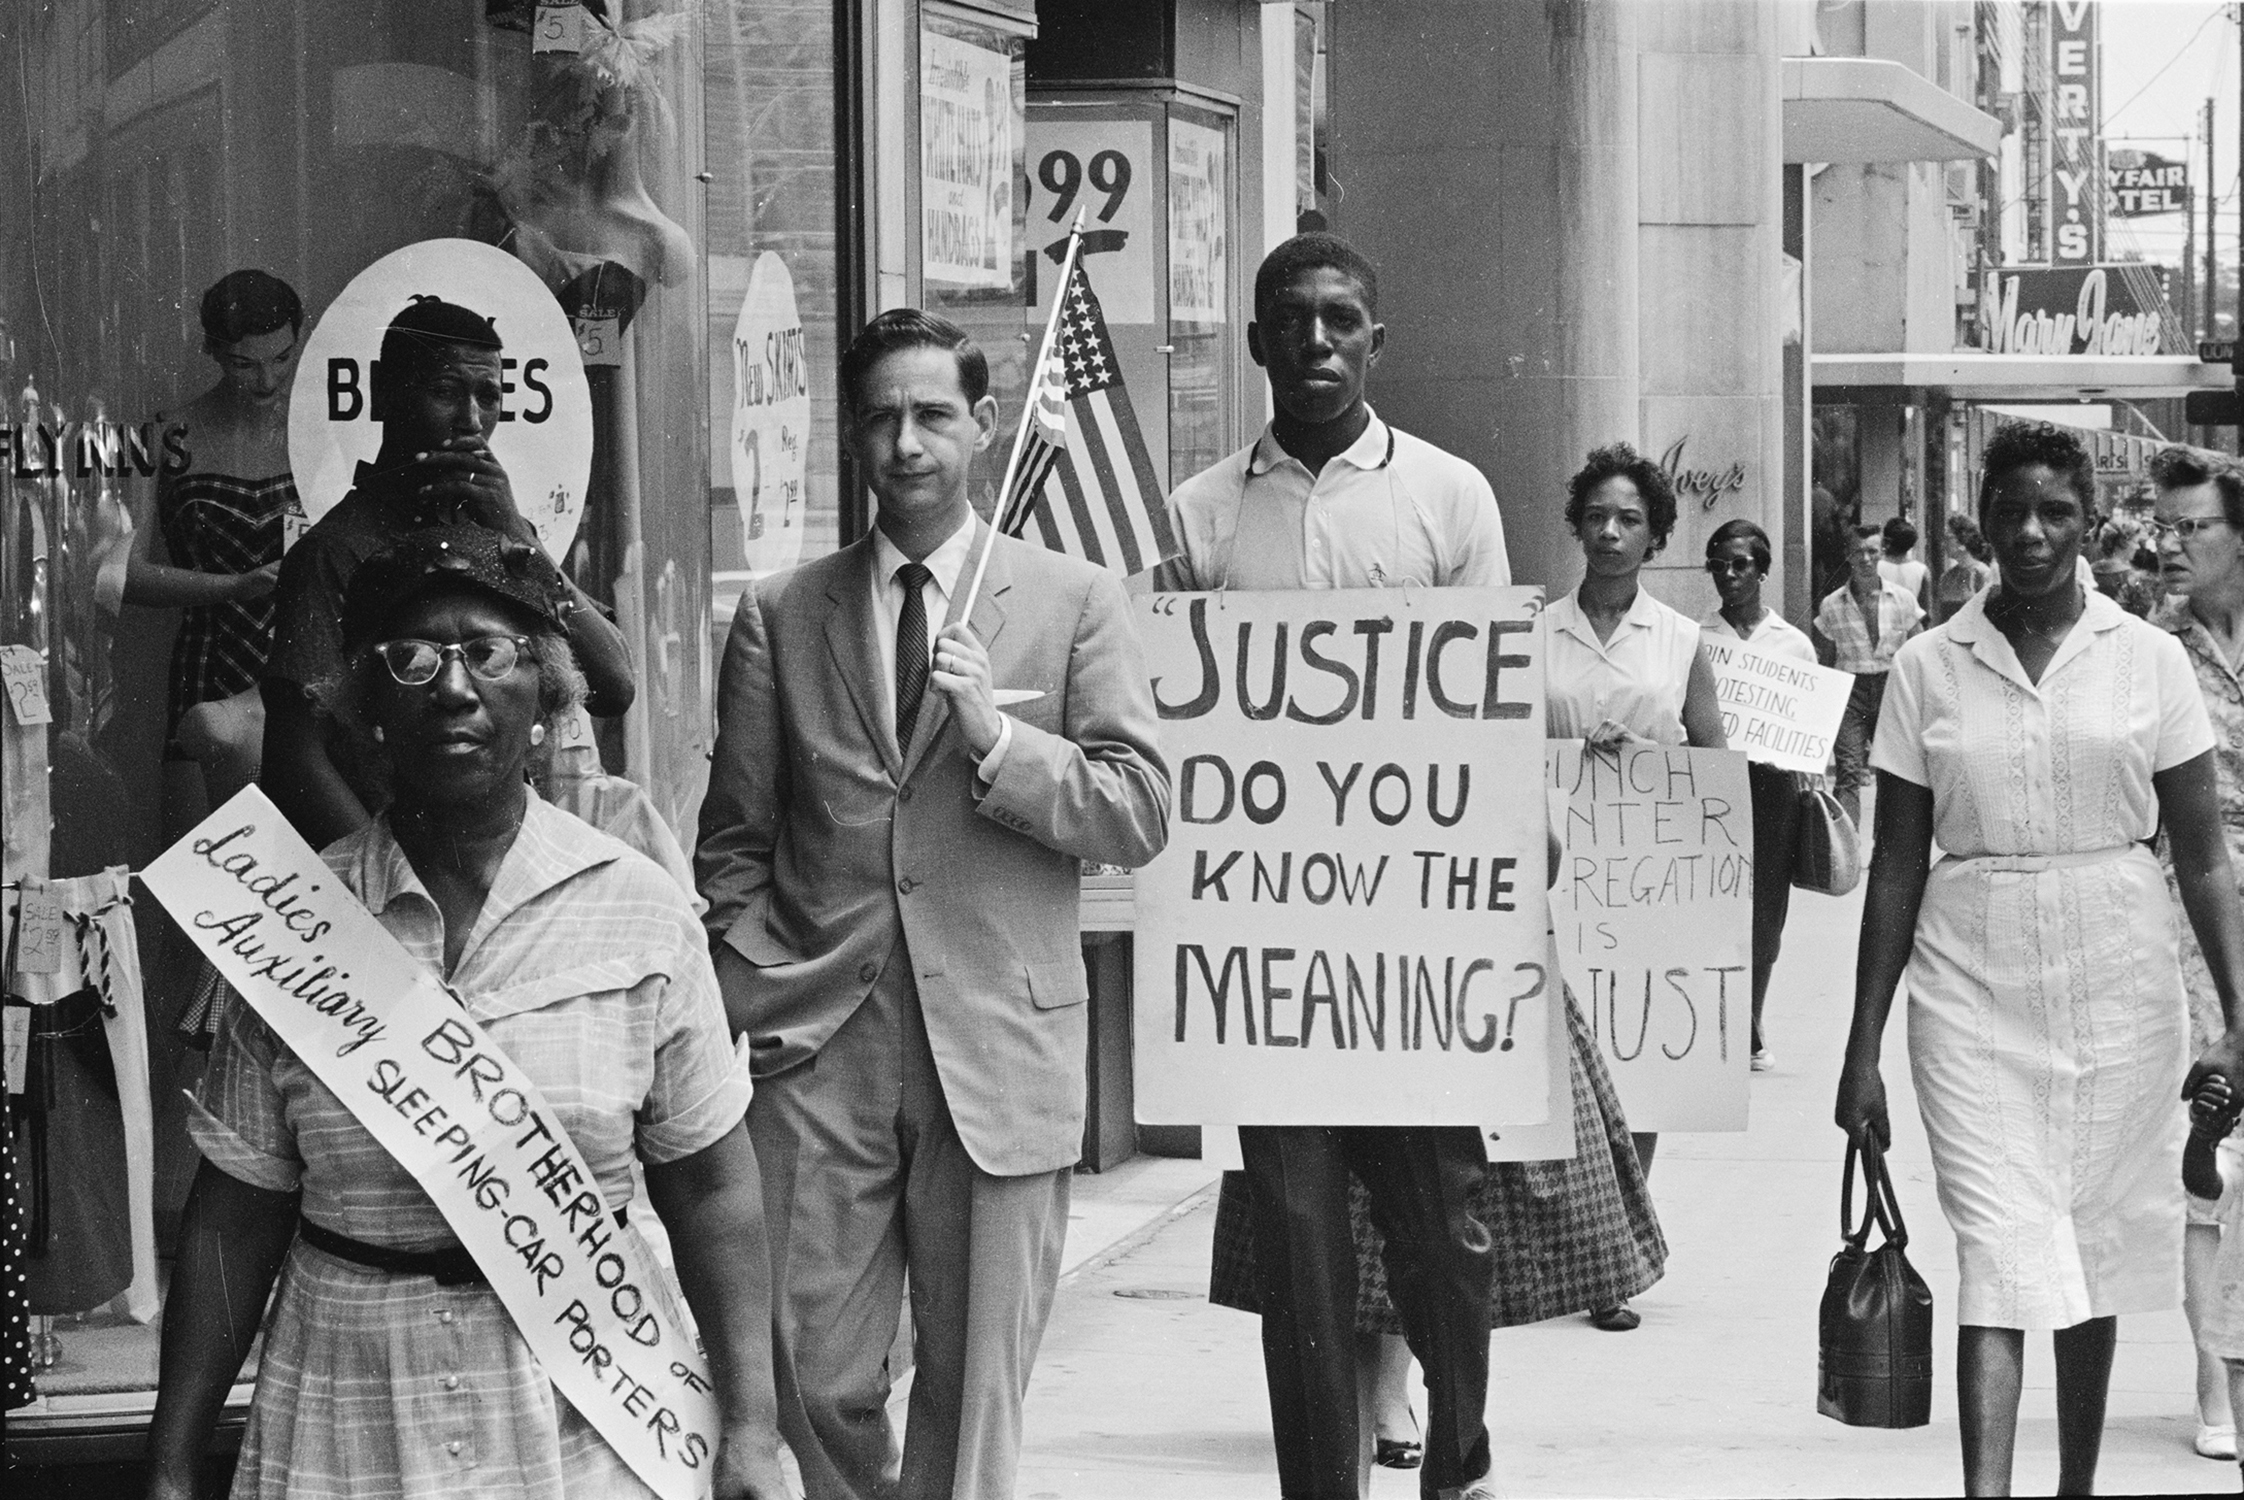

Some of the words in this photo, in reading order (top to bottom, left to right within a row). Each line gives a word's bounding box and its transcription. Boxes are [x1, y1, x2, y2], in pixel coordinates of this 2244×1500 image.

[1980, 271, 2076, 355] Mary
[2077, 269, 2161, 356] Jane
[1738, 653, 1819, 692] STUDENTS
[1744, 717, 1828, 759] FACILITIES
[1180, 754, 1287, 825] DO
[1316, 761, 1470, 828] YOU
[193, 824, 332, 943] Ladies
[1192, 850, 1390, 907] KNOW
[1413, 850, 1517, 912] THE
[1578, 922, 1618, 954] IS
[194, 910, 387, 1057] Auxiliary
[1175, 944, 1547, 1053] MEANING?
[421, 1018, 660, 1347] BROTHERHOOD
[669, 1360, 712, 1394] OF
[366, 1058, 564, 1298] SLEEPING-CAR
[553, 1299, 709, 1460] PORTERS
